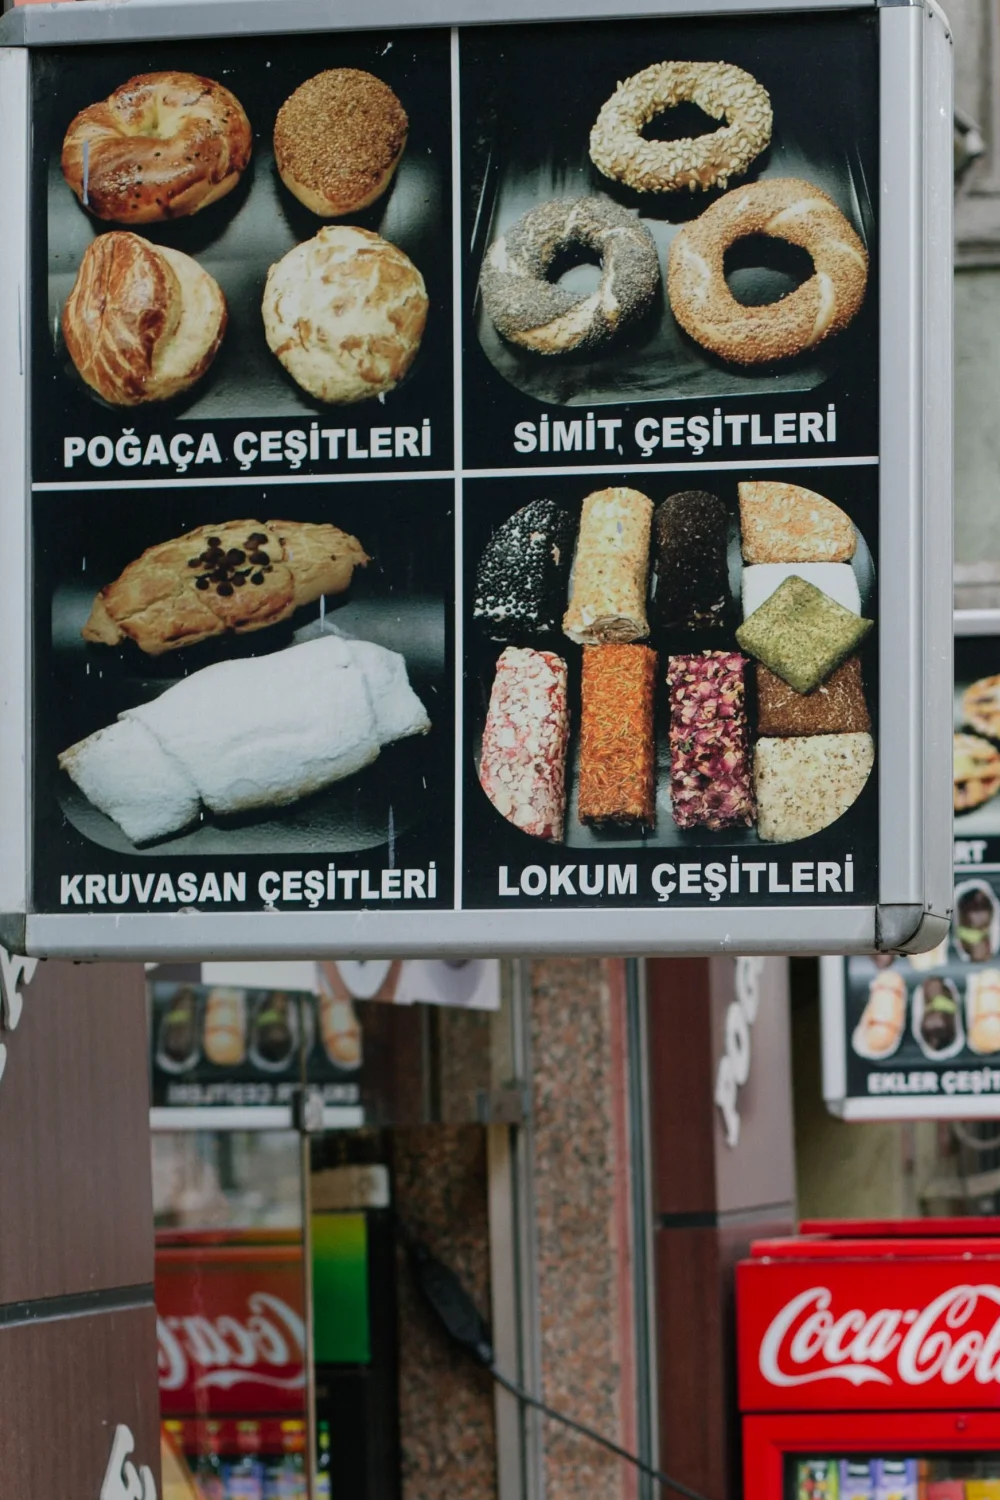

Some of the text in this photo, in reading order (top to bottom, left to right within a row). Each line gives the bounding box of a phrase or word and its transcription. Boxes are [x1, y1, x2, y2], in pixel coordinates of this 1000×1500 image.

[63, 418, 432, 473] POĞAÇA ÇEŞİTLERİ
[513, 403, 837, 456] SİMİT ÇEŞİTLERİ
[60, 860, 437, 909] KRUVASAN ÇEŞİTLERİ
[498, 854, 854, 903] LOKUM ÇEŞİTLERİ
[867, 1071, 939, 1094] EKLER
